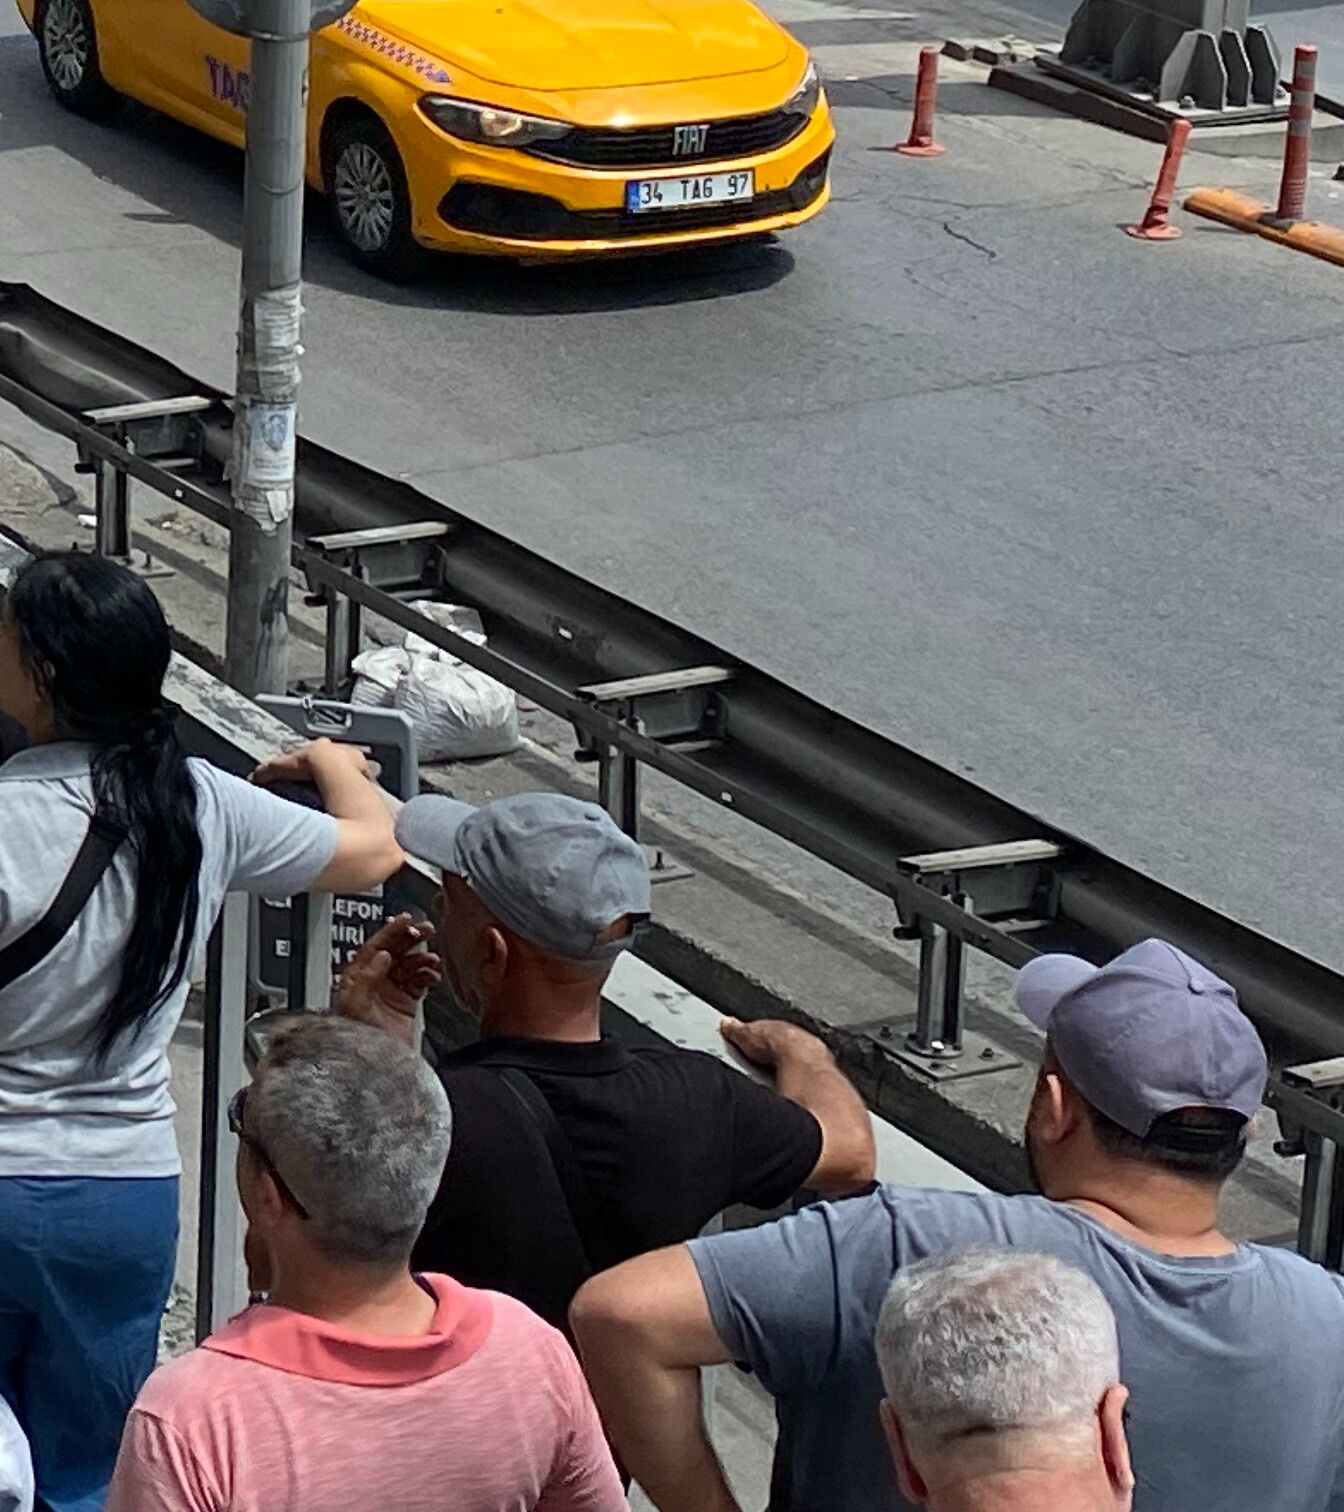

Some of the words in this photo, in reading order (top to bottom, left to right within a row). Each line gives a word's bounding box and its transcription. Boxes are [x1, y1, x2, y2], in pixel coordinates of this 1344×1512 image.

[641, 182, 663, 204] 34
[681, 177, 713, 200] TAG
[727, 173, 749, 196] 97
